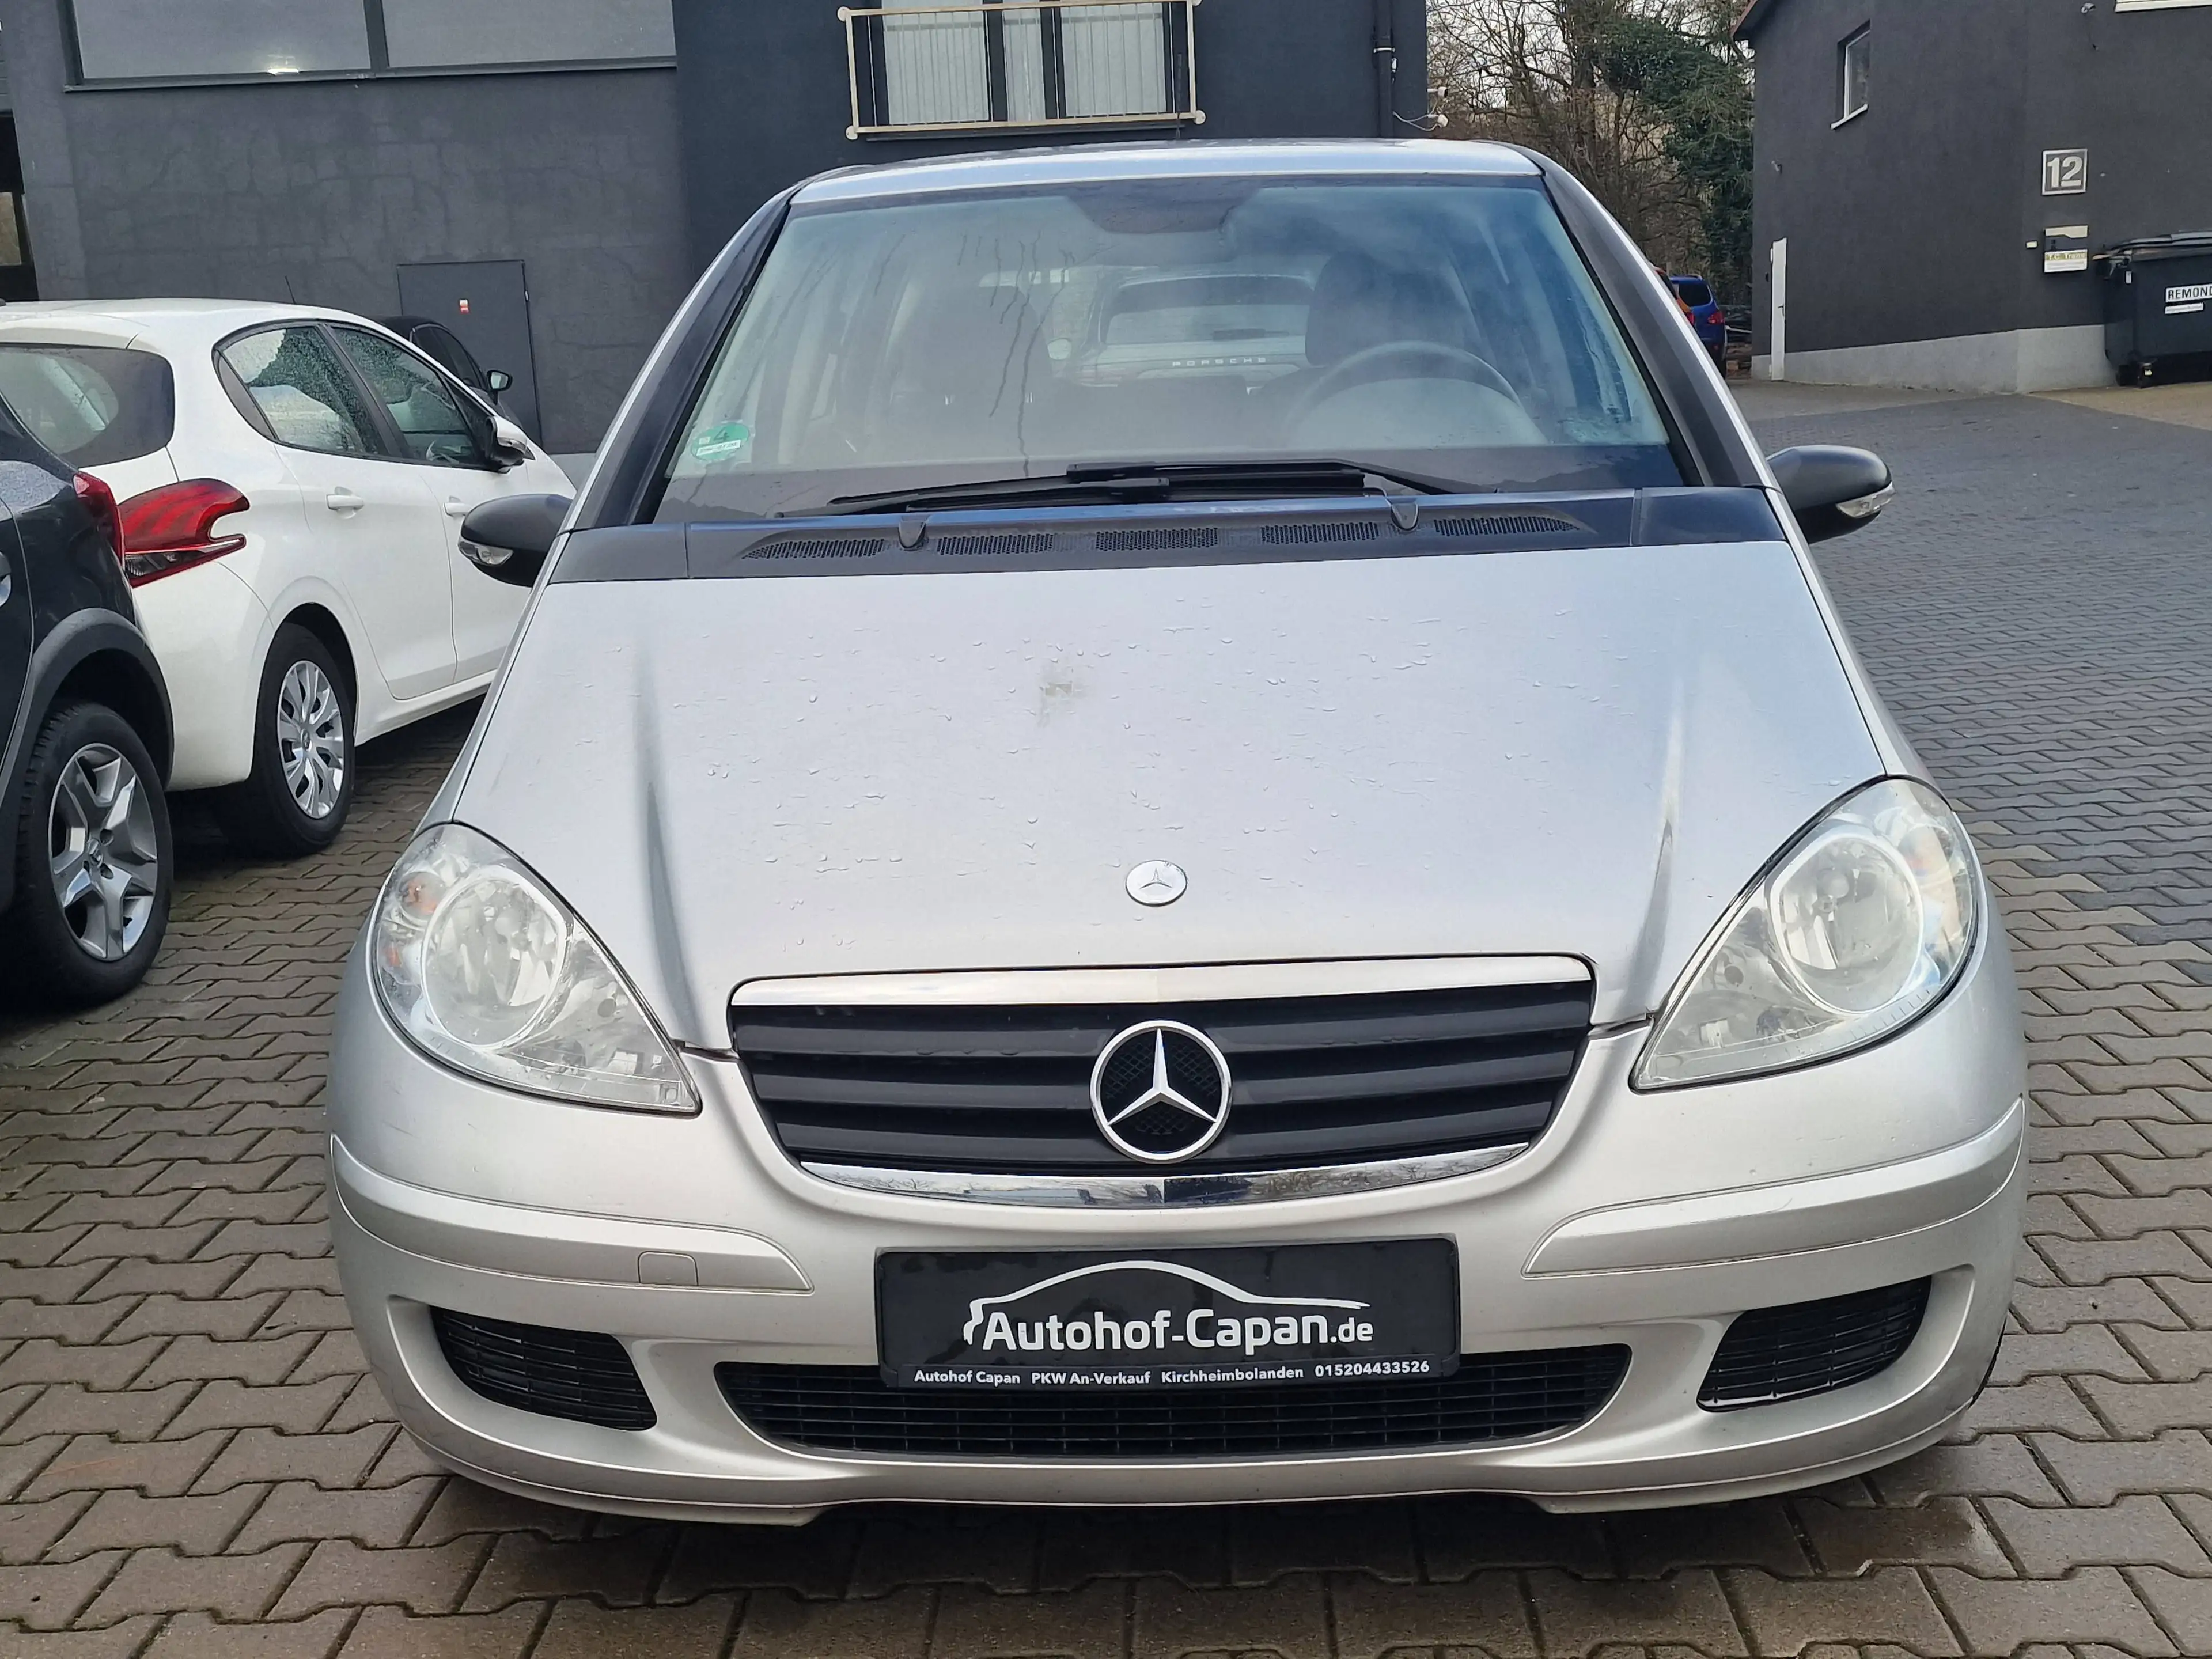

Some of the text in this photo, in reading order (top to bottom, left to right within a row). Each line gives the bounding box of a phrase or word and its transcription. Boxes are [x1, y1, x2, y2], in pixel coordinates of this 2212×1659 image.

[2047, 156, 2082, 188] 12
[1172, 357, 1267, 367] PORSCHE
[714, 426, 730, 441] 4
[982, 1309, 1373, 1355] Autohof-Capan.de
[914, 1360, 1430, 1387] Autohof Capan PKW An-Verkauf Kirchheimbolanden 015204433526
